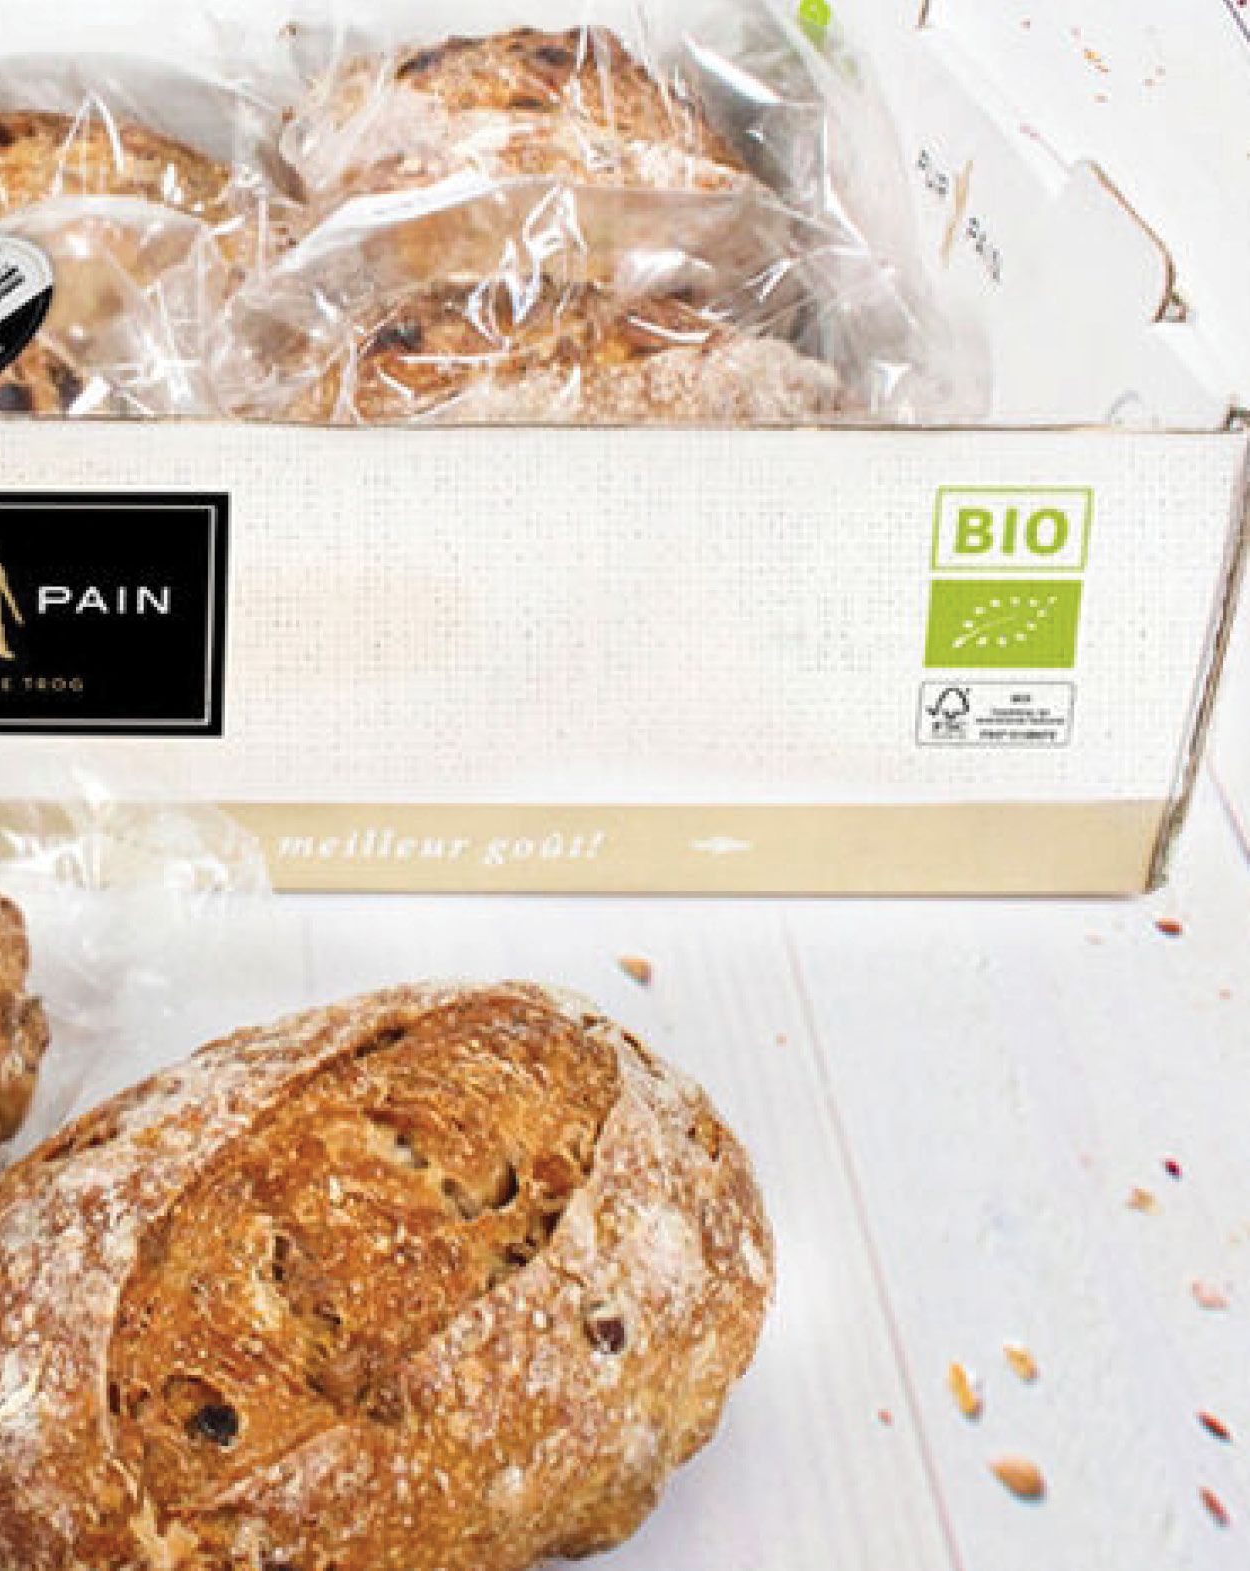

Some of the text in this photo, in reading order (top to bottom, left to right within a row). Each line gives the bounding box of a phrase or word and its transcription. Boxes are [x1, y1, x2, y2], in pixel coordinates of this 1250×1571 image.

[955, 508, 1069, 554] BIO
[38, 585, 172, 615] PAIN
[278, 829, 472, 859] meilleur
